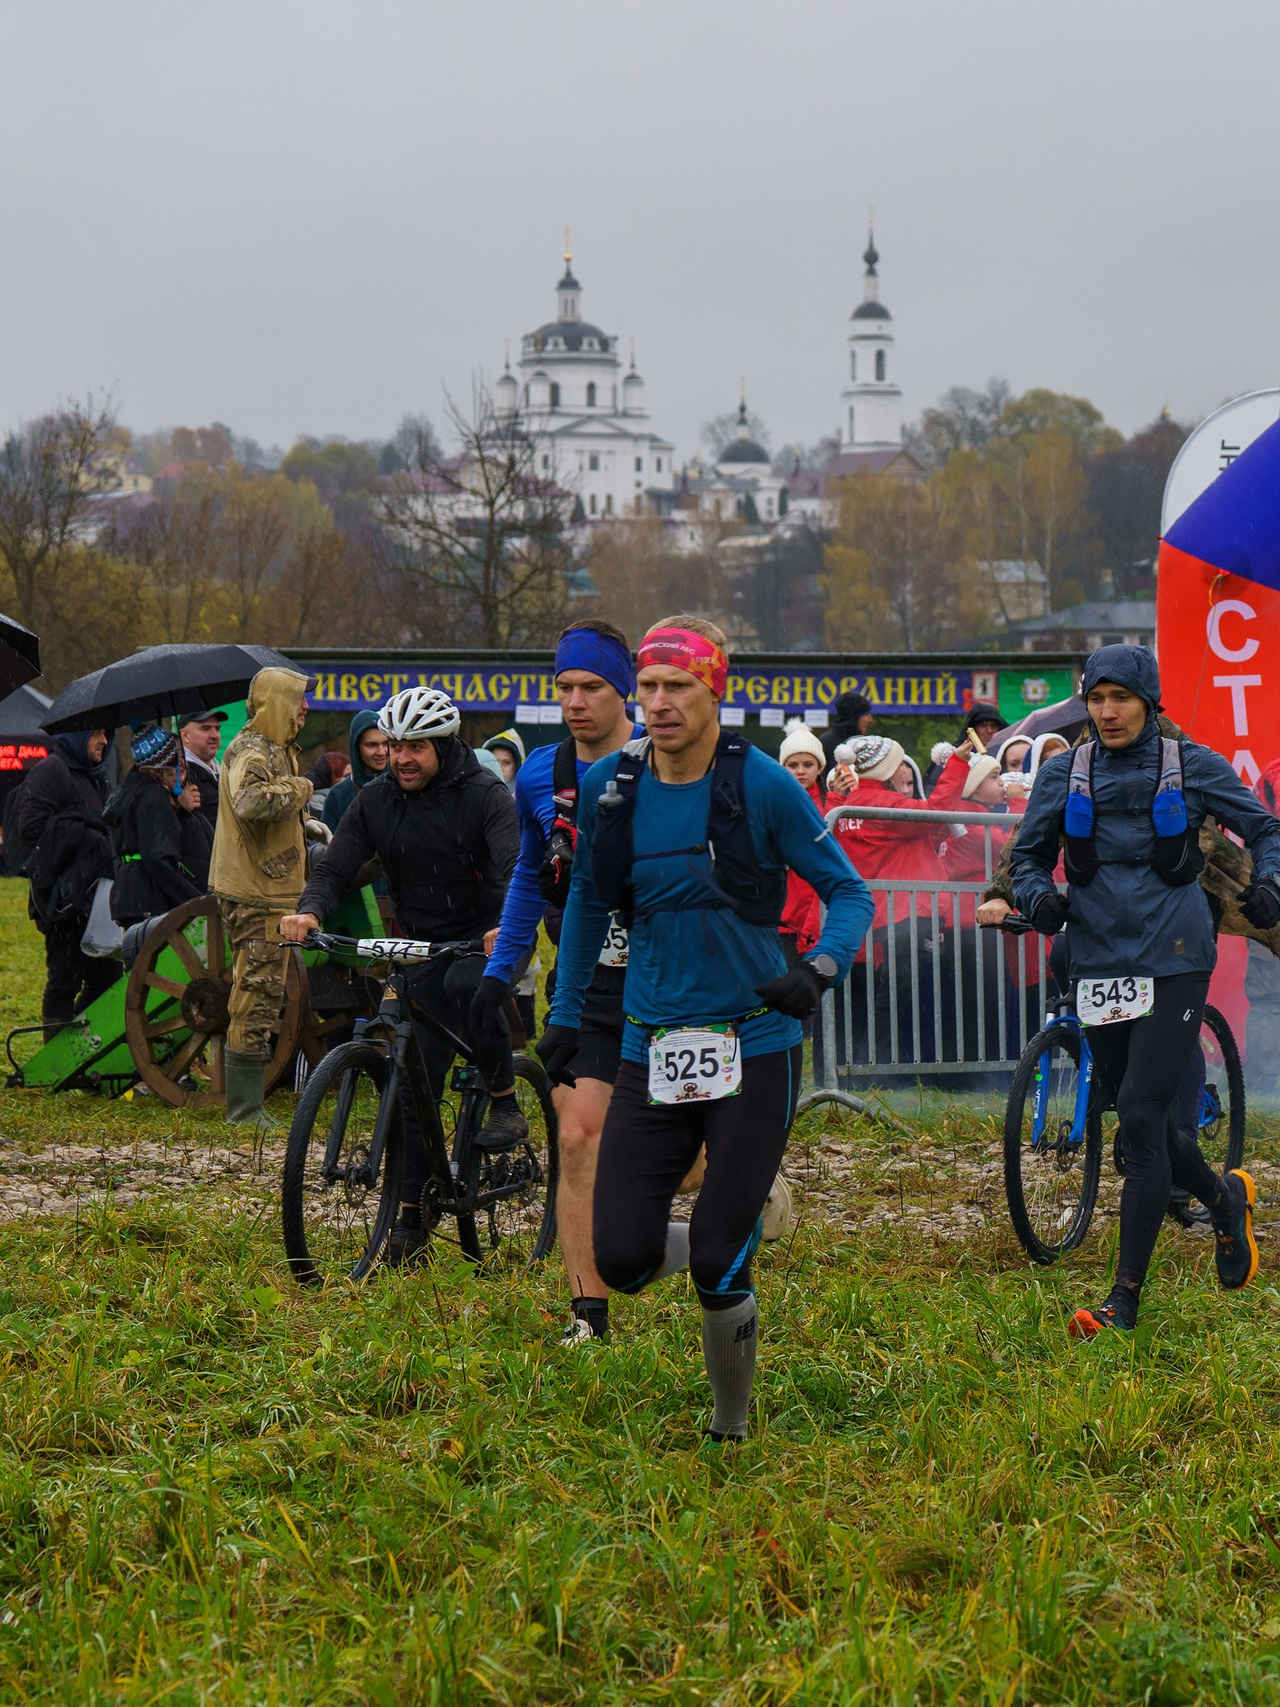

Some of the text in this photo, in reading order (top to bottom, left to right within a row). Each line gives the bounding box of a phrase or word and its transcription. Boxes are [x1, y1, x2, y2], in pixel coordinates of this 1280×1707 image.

[313, 671, 958, 705] ИВЕТ УЧАСТН РЕВНОВАНИЙ
[1206, 599, 1263, 794] СТА
[371, 940, 414, 960] 577
[1091, 977, 1137, 1008] 543
[665, 1047, 719, 1082] 525
